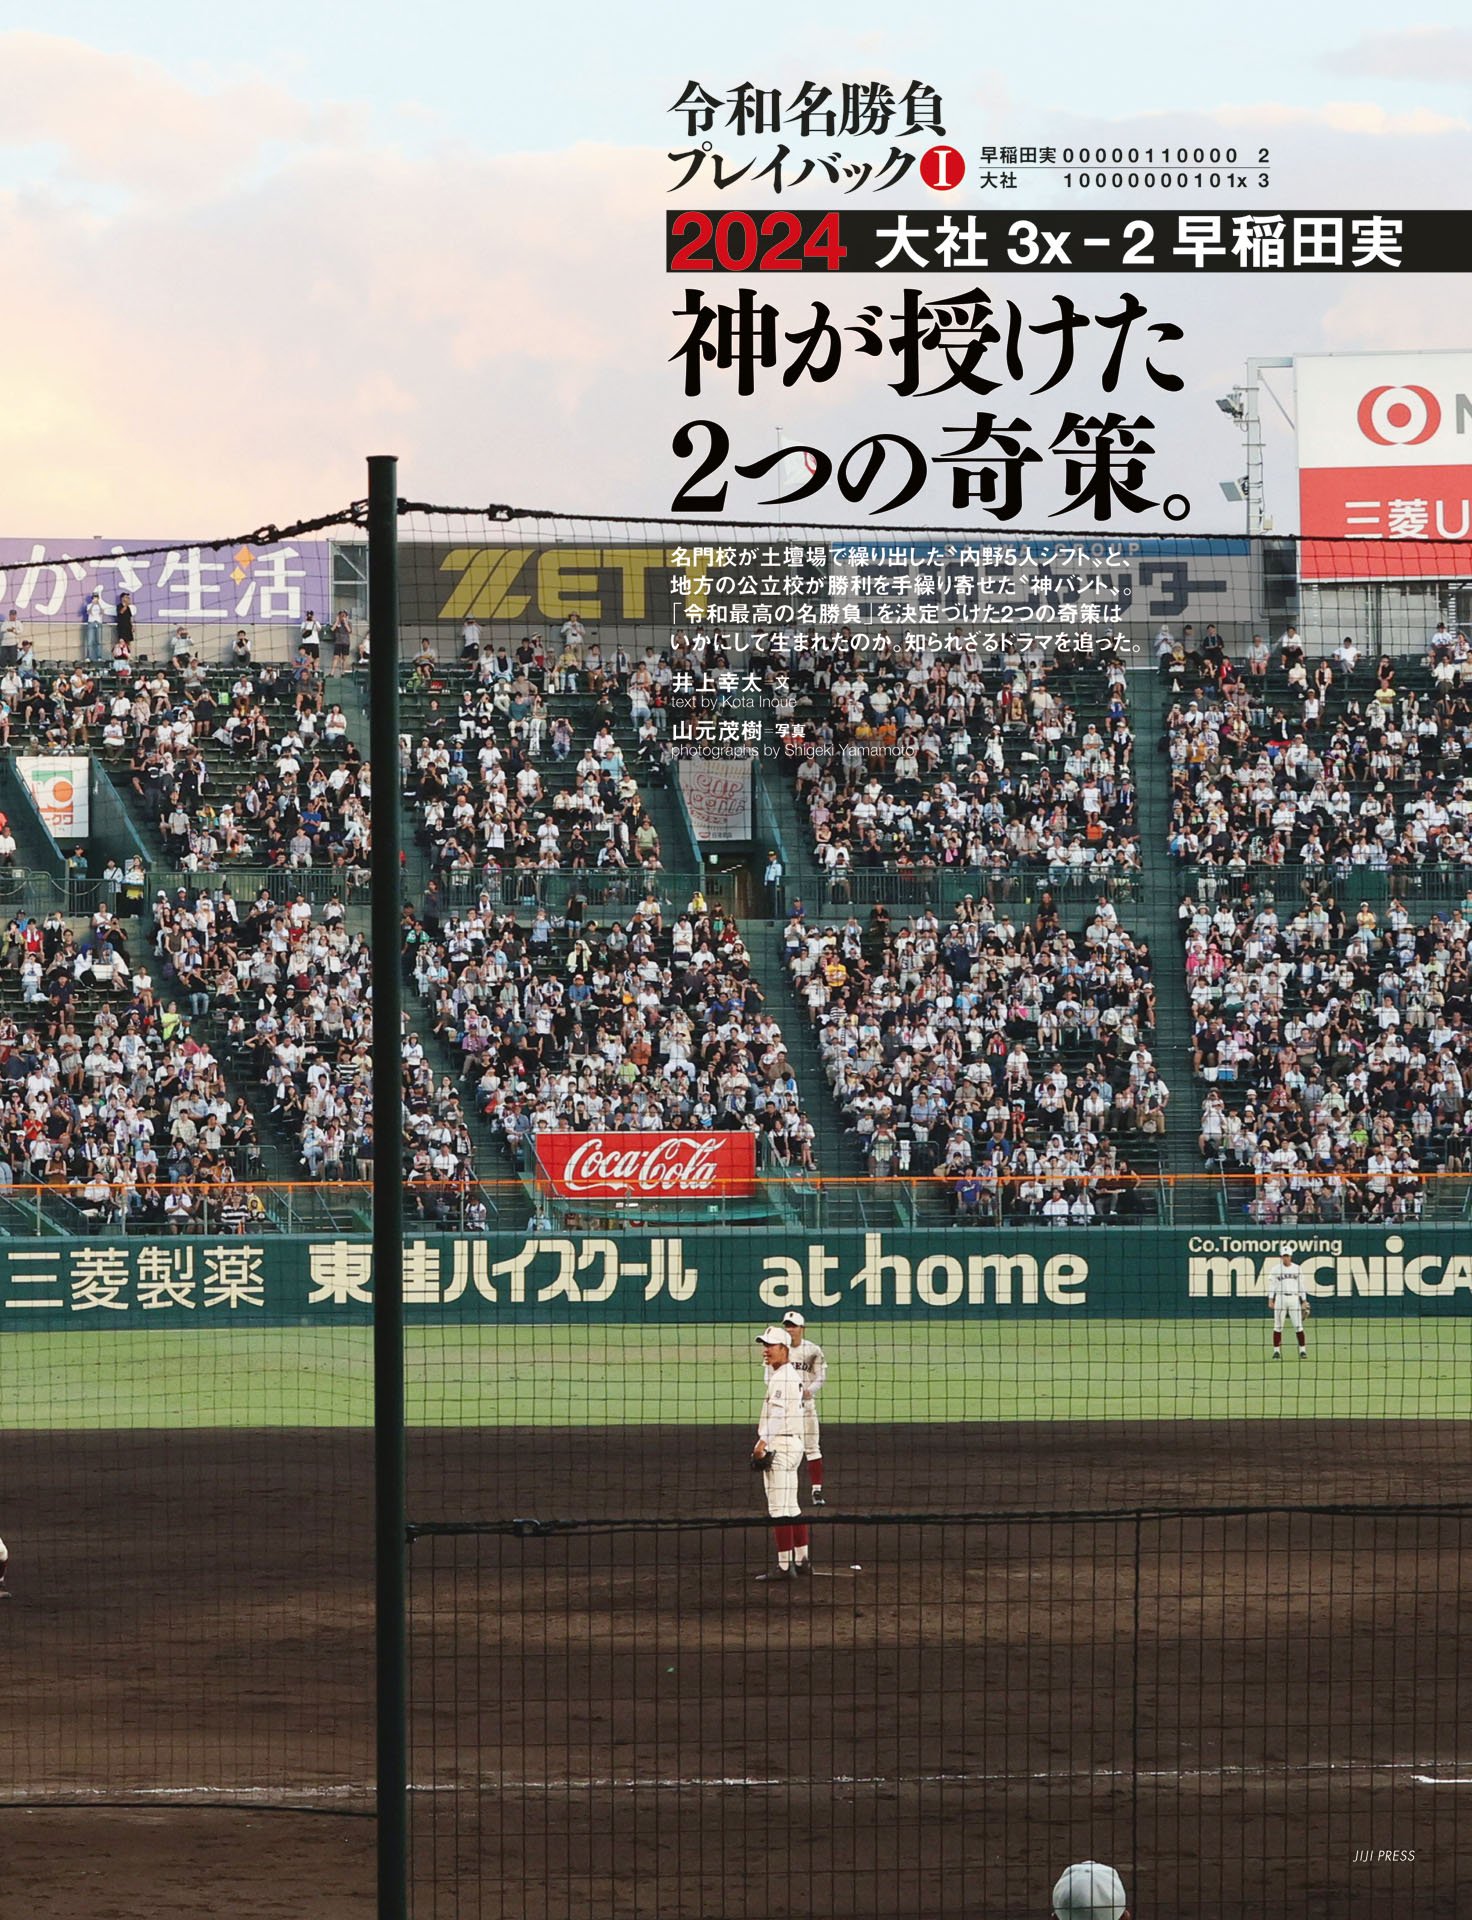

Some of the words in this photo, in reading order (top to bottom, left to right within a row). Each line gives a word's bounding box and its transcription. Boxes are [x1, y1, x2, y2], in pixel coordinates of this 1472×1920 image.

[0, 544, 306, 619] かさ生活
[564, 1138, 727, 1190] Coca-Cola
[5, 1244, 265, 1311] 三菱製薬
[759, 1245, 842, 1307] at
[850, 1232, 1089, 1306] home
